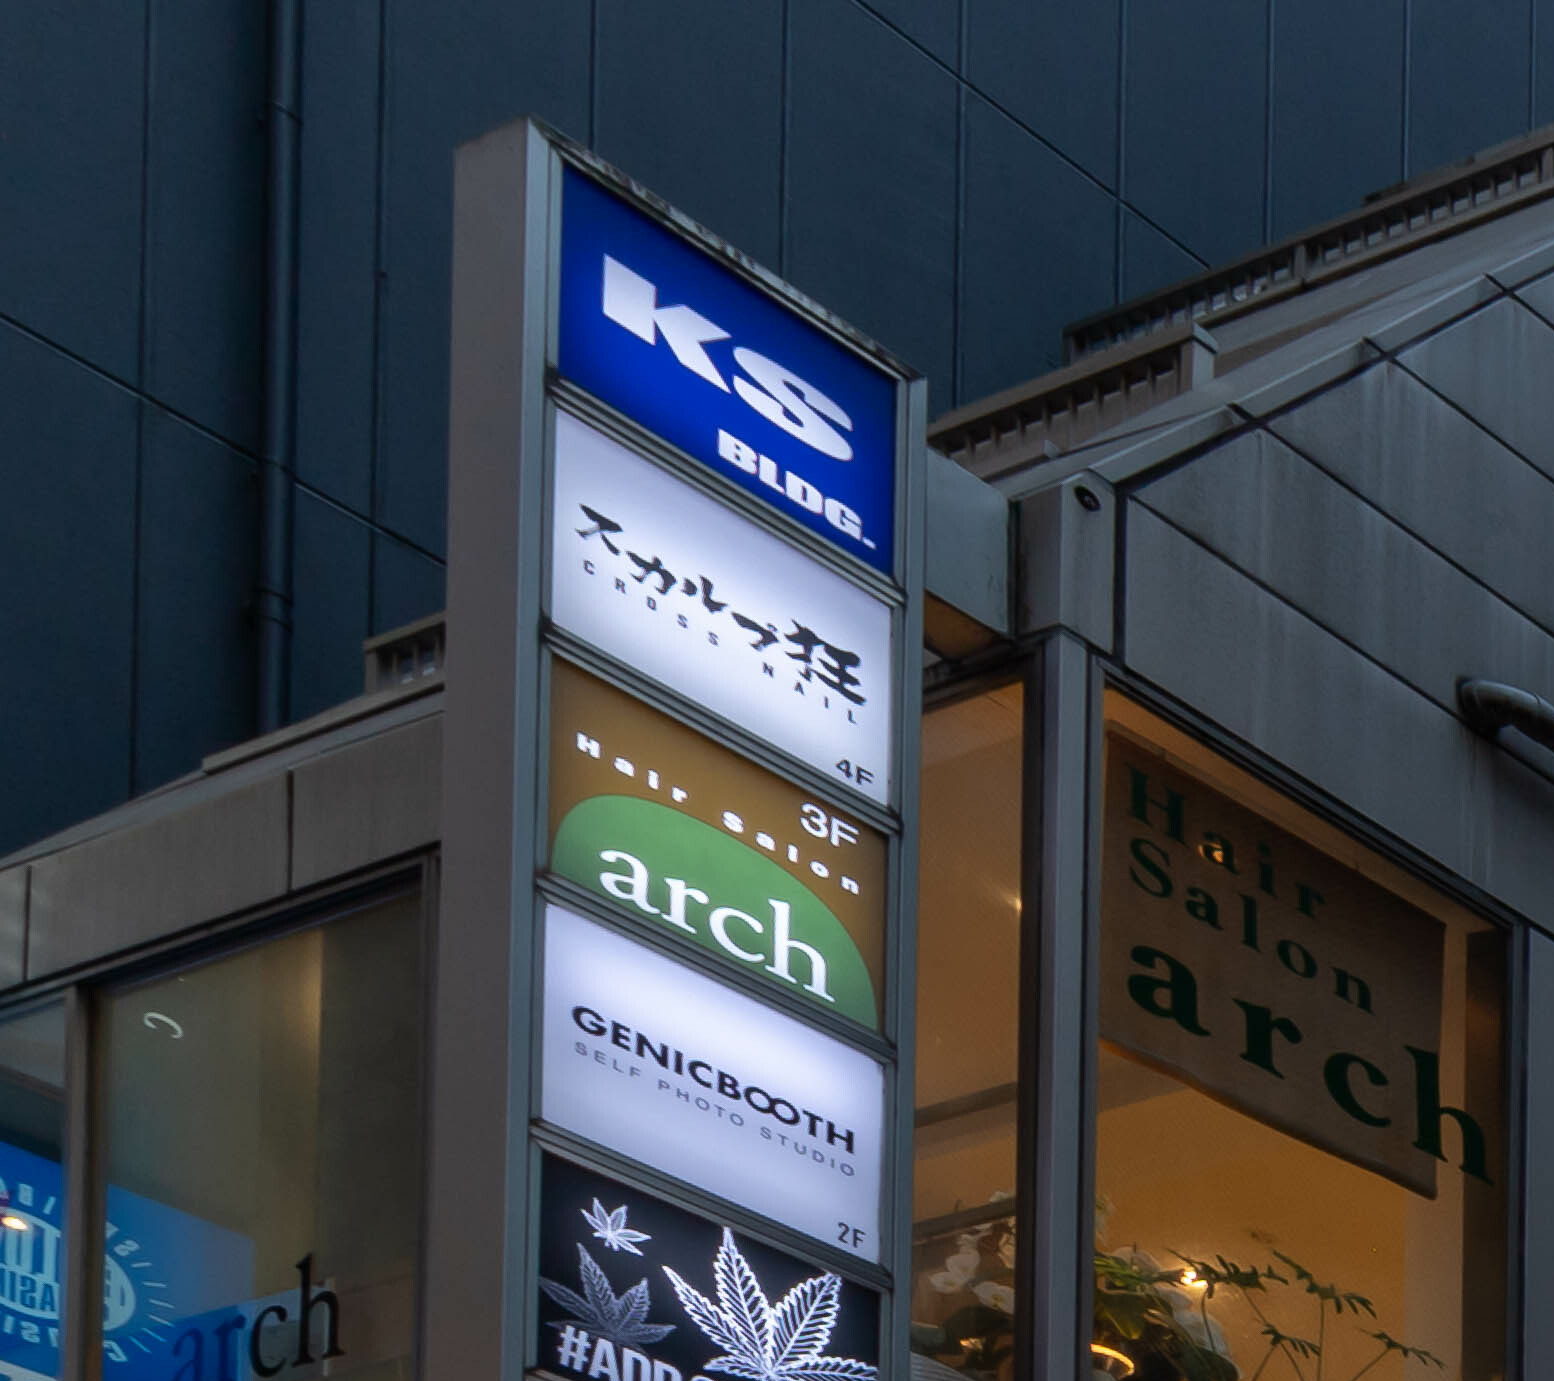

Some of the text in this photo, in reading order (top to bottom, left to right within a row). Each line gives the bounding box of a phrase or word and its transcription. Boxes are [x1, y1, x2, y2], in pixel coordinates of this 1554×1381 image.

[602, 254, 853, 463] KS
[717, 427, 877, 550] BLDG.
[575, 503, 867, 706] スカルプ狂
[582, 559, 857, 724] CROSS NAIL
[575, 730, 861, 897] Hair Salon
[800, 802, 860, 851] 3F
[835, 758, 875, 786] 4F
[1125, 764, 1326, 921] Hair
[599, 847, 836, 1005] arch
[1127, 836, 1376, 1016] Salon
[571, 1003, 857, 1156] GENICBOOTH
[573, 1040, 856, 1178] SELF PHOTO STUDIO
[1126, 943, 1496, 1186] arch
[836, 1219, 867, 1250] 2F
